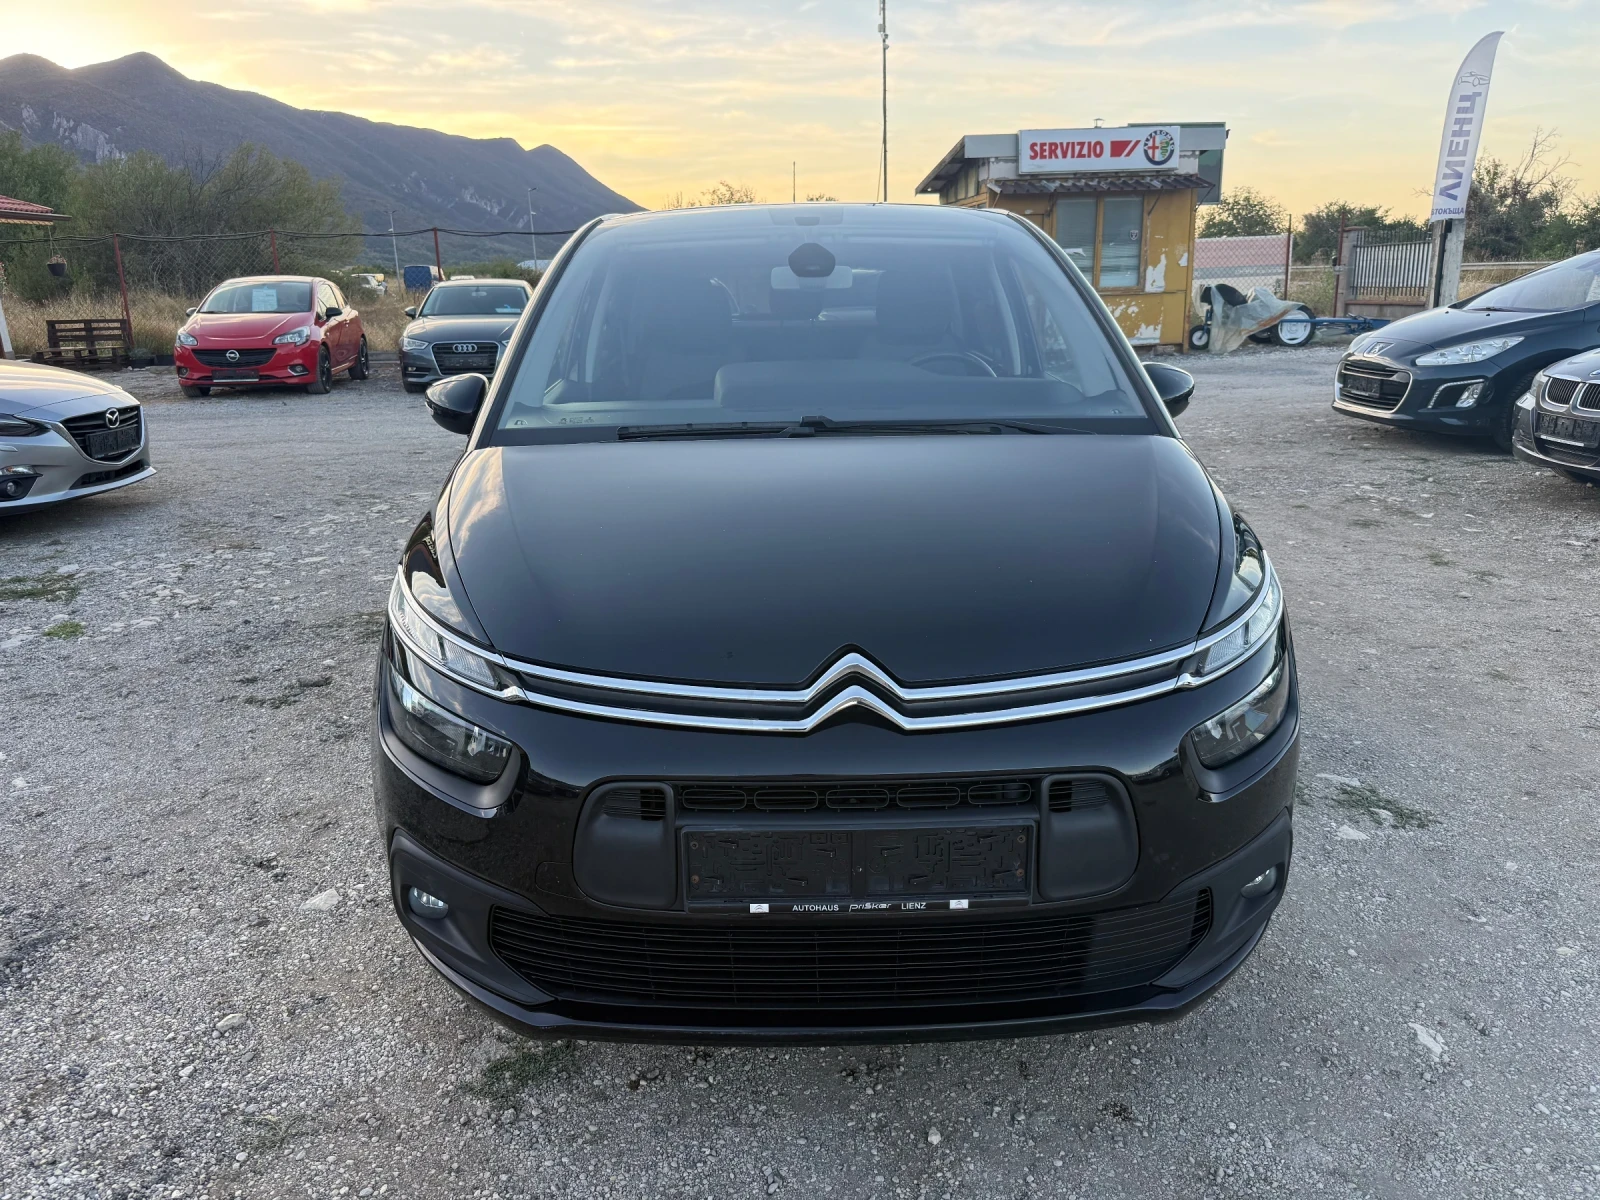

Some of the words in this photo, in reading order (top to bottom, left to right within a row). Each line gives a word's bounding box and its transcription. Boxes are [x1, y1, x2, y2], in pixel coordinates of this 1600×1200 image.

[1029, 140, 1104, 160] SERVIZIO
[1439, 91, 1482, 201] ЛИЕНЦ
[792, 904, 839, 912] AUTOHAUS
